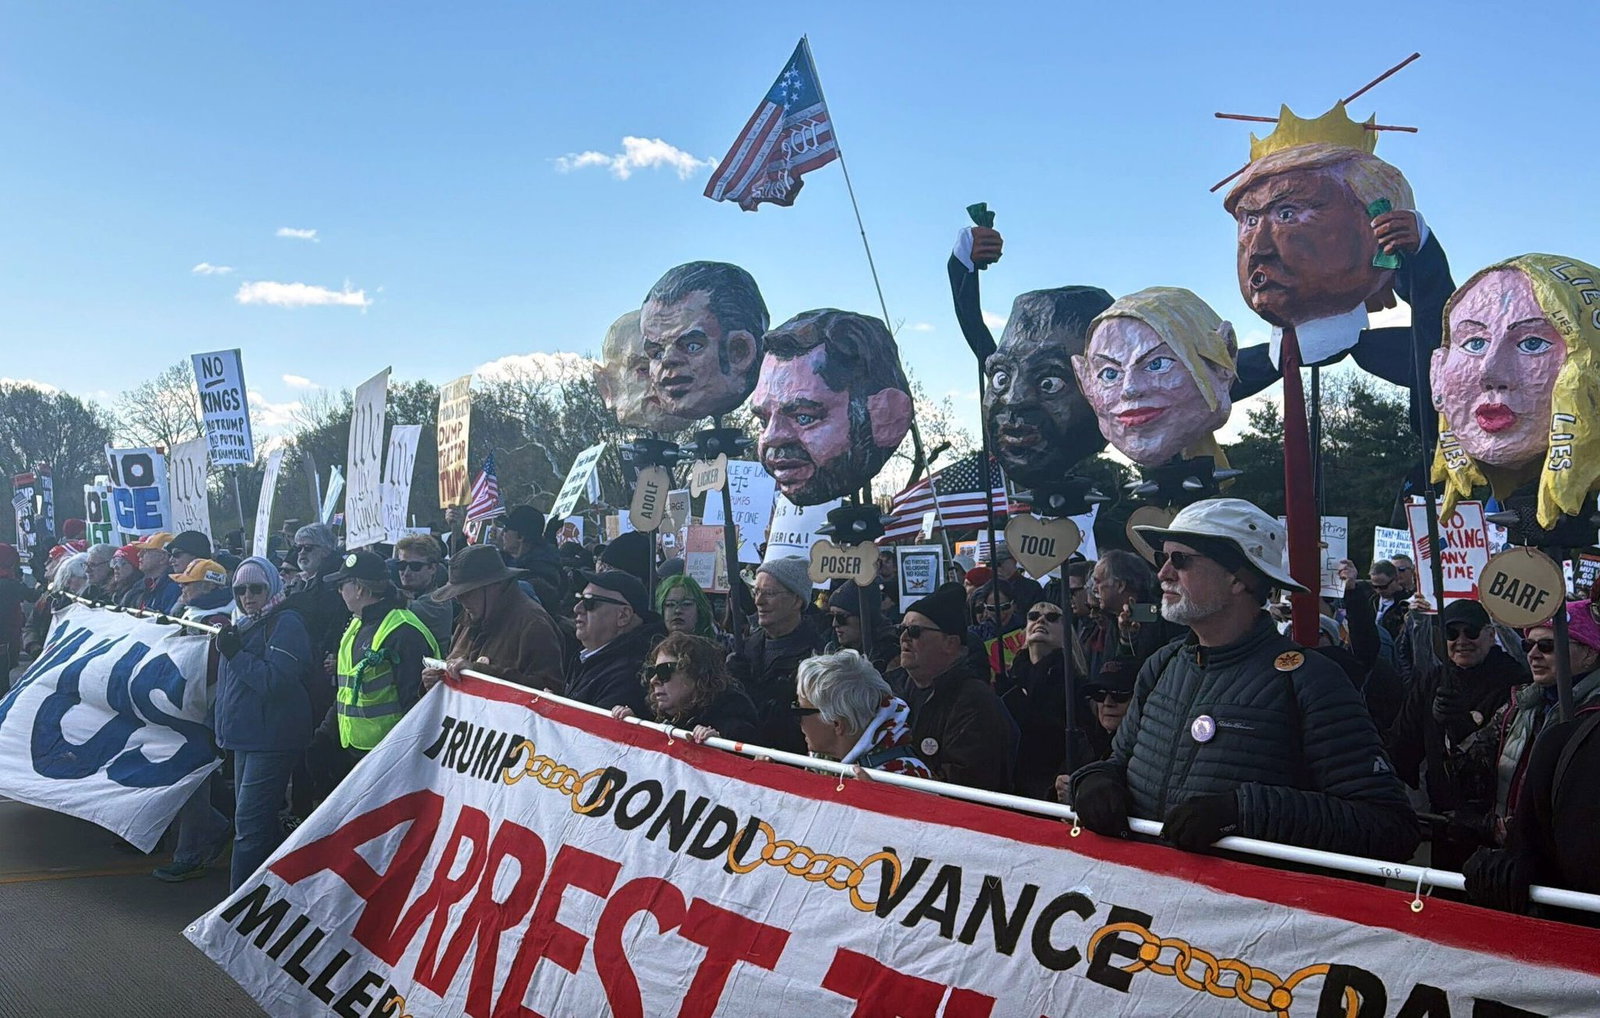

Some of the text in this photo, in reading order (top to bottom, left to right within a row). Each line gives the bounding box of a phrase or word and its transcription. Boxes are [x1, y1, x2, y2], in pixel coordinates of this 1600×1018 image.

[1553, 310, 1574, 336] LIES
[201, 356, 224, 379] NO
[200, 388, 241, 414] KINGS
[206, 417, 245, 432] NO TRUMP
[439, 421, 463, 447] DUMP
[209, 434, 245, 447] NO PUTIN
[1439, 430, 1468, 470] LIES
[1549, 412, 1576, 472] LIES
[743, 466, 753, 475] OF
[640, 480, 659, 519] ADOLF
[744, 511, 760, 524] ONE
[1020, 535, 1057, 558] TOOL
[1446, 528, 1484, 549] KING
[821, 556, 861, 575] POSER
[1440, 551, 1468, 564] ANY
[1442, 565, 1474, 580] IME
[1489, 571, 1549, 613] BARF
[423, 716, 525, 784] TRUMP
[586, 766, 761, 874] BONDI
[874, 846, 1153, 994] VANCE
[1379, 866, 1402, 879] TOP
[268, 788, 791, 1018] ARREST
